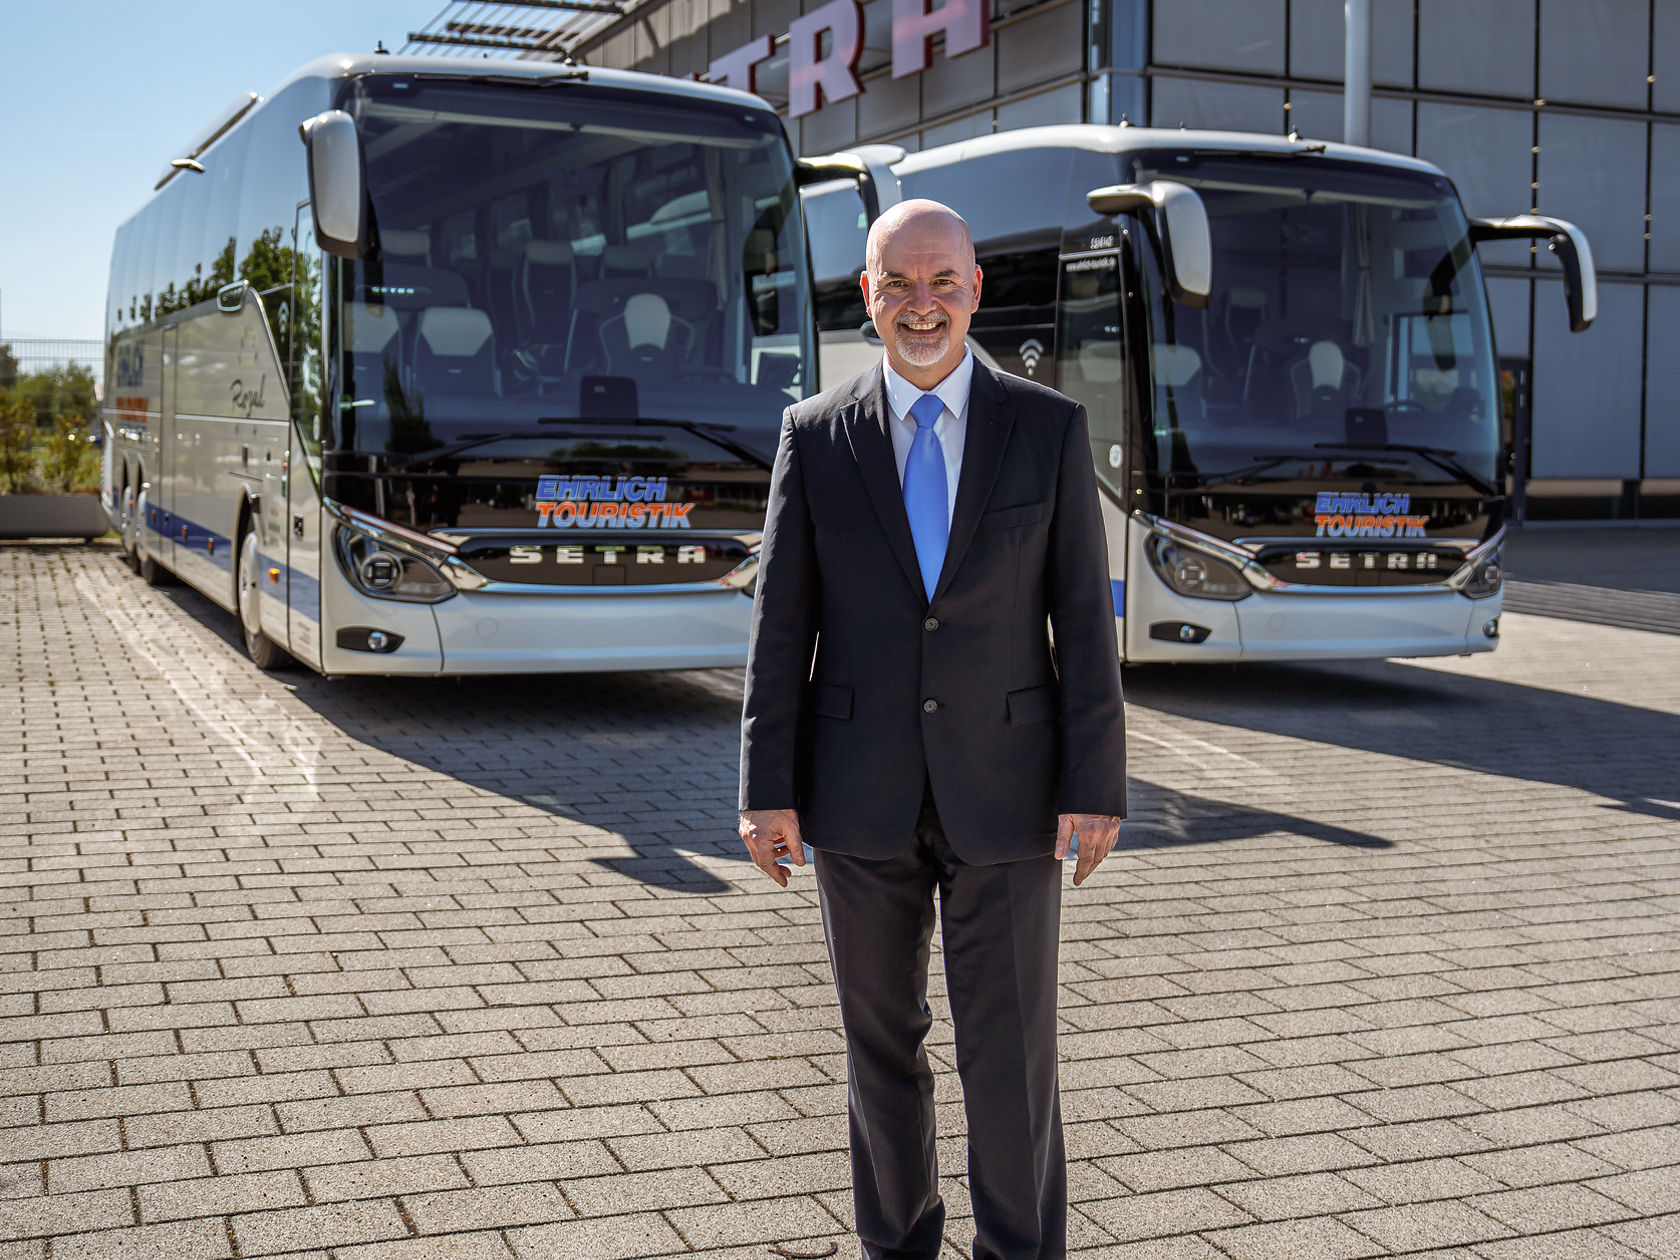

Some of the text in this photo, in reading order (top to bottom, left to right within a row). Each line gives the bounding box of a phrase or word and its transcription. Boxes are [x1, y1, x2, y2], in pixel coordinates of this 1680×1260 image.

[230, 373, 266, 419] Royal
[535, 474, 668, 501] EHRLICH
[1315, 491, 1410, 514] EHRLICH
[535, 502, 696, 528] TOURISTIK
[1314, 515, 1430, 537] TOURISTIK
[509, 545, 706, 564] SETRA
[1295, 551, 1438, 569] SETRA
